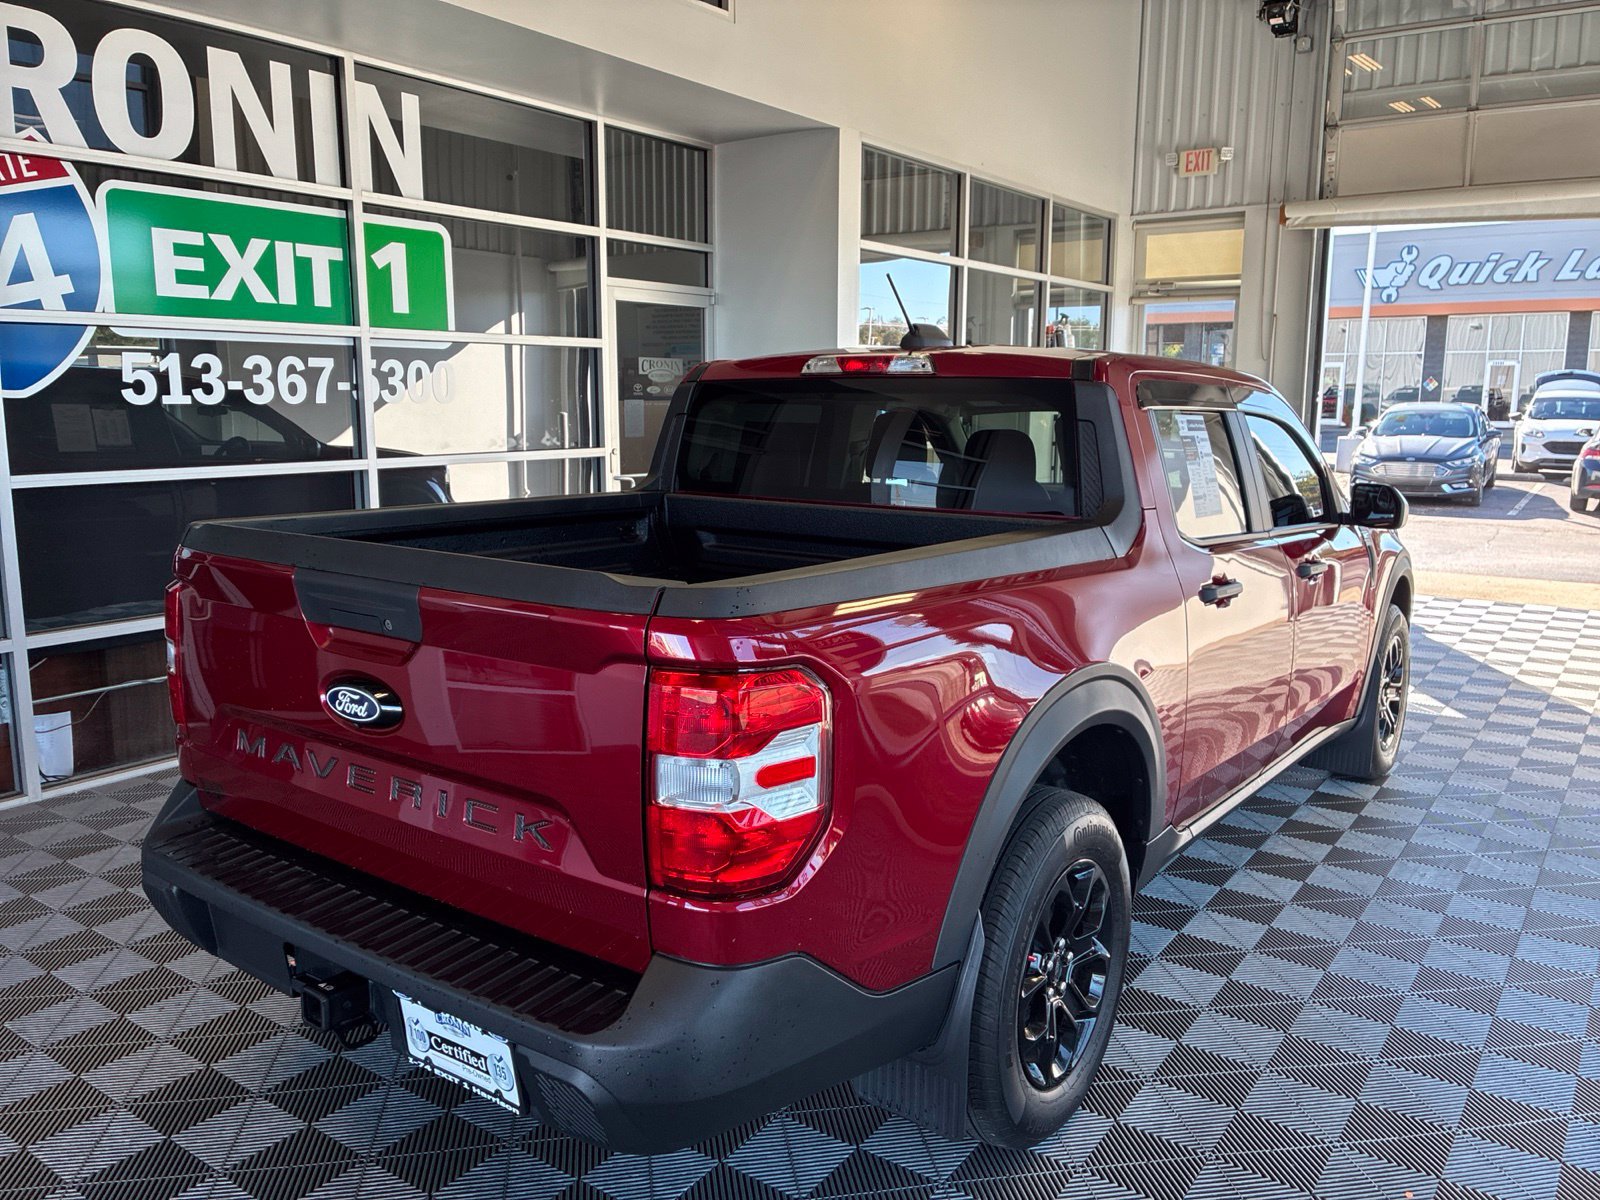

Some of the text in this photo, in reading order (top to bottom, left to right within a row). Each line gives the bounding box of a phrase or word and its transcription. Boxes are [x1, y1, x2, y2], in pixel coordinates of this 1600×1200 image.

[0, 153, 38, 180] TE
[1185, 150, 1212, 172] EXIT
[151, 227, 409, 314] EXIT 1
[1418, 250, 1553, 290] Quick
[641, 359, 681, 373] CRONIN
[335, 690, 368, 718] Ford
[236, 728, 554, 852] MAVERICK
[430, 1036, 487, 1071] Certified
[434, 1068, 460, 1084] EXIT
[462, 1082, 470, 1090] 1
[472, 1086, 519, 1115] Harrison
